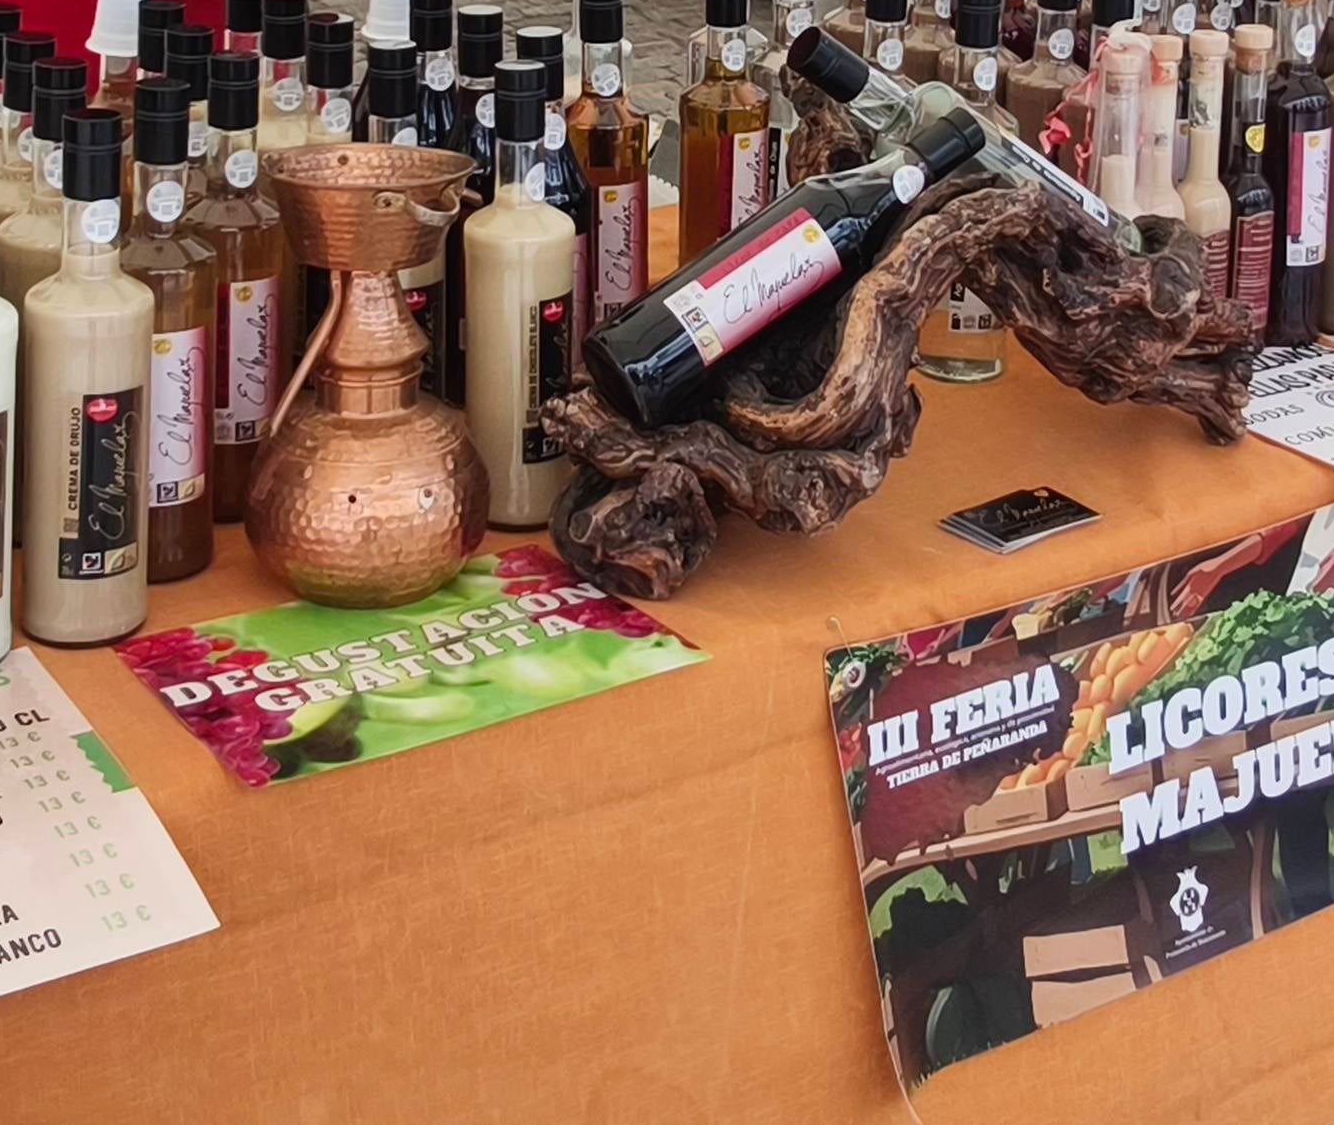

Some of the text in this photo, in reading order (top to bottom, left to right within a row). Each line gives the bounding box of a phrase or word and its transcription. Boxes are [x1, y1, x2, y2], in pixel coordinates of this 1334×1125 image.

[723, 282, 752, 324] El
[68, 407, 81, 510] CREMA DE ORUJO
[158, 431, 193, 465] El
[88, 502, 124, 539] El
[160, 582, 607, 707] DEGUSTACIÓN
[254, 614, 585, 712] GRATUITA
[14, 709, 51, 727] CL
[867, 709, 919, 766] III
[930, 664, 1060, 744] FERIA
[27, 731, 41, 743] €
[10, 750, 55, 769] 13 €
[887, 759, 939, 789] TIERRA
[942, 749, 961, 768] DE
[963, 720, 1048, 762] PEÑARANDA
[23, 769, 70, 790] 13 €
[38, 791, 86, 813] 13 €
[54, 815, 102, 839] 13 €
[69, 843, 118, 868] 13 €
[85, 873, 135, 899] 13 €
[101, 904, 152, 932] 13 €
